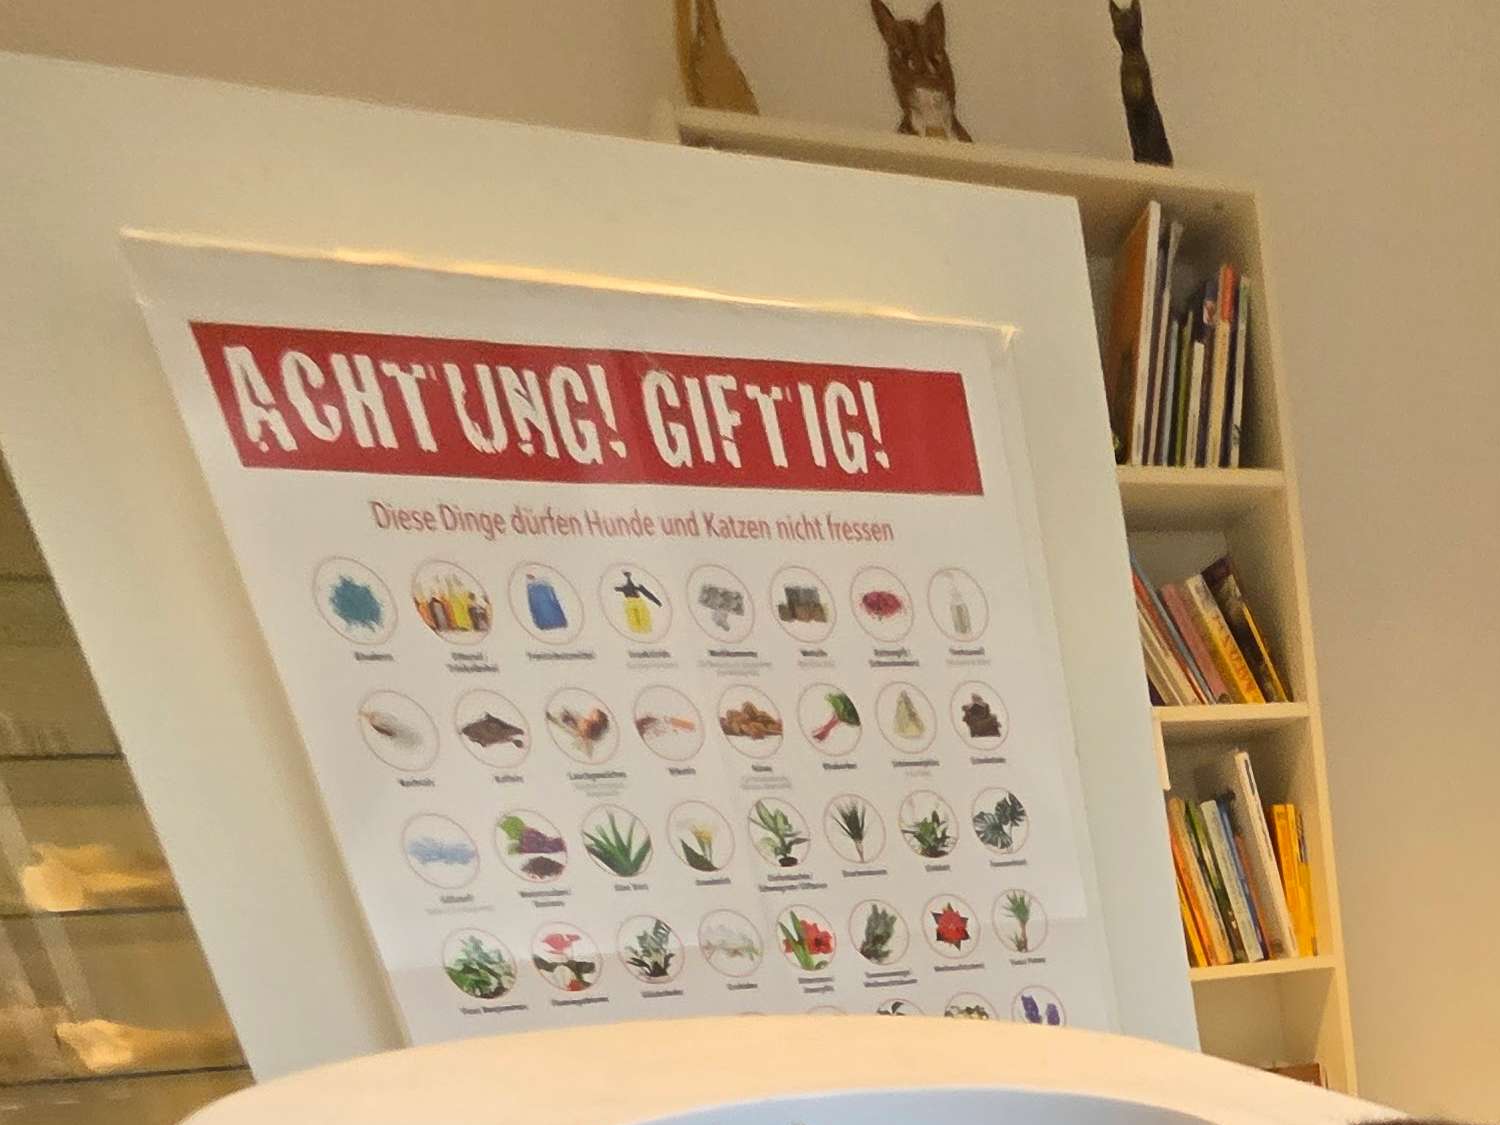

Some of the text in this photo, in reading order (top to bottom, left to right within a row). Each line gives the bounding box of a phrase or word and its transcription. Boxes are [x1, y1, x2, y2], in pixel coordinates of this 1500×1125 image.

[224, 345, 890, 474] ACHTUNG! GIFTIG!
[370, 499, 895, 543] Diese Dinge dürfen Hunde und Katzen nicht fressen
